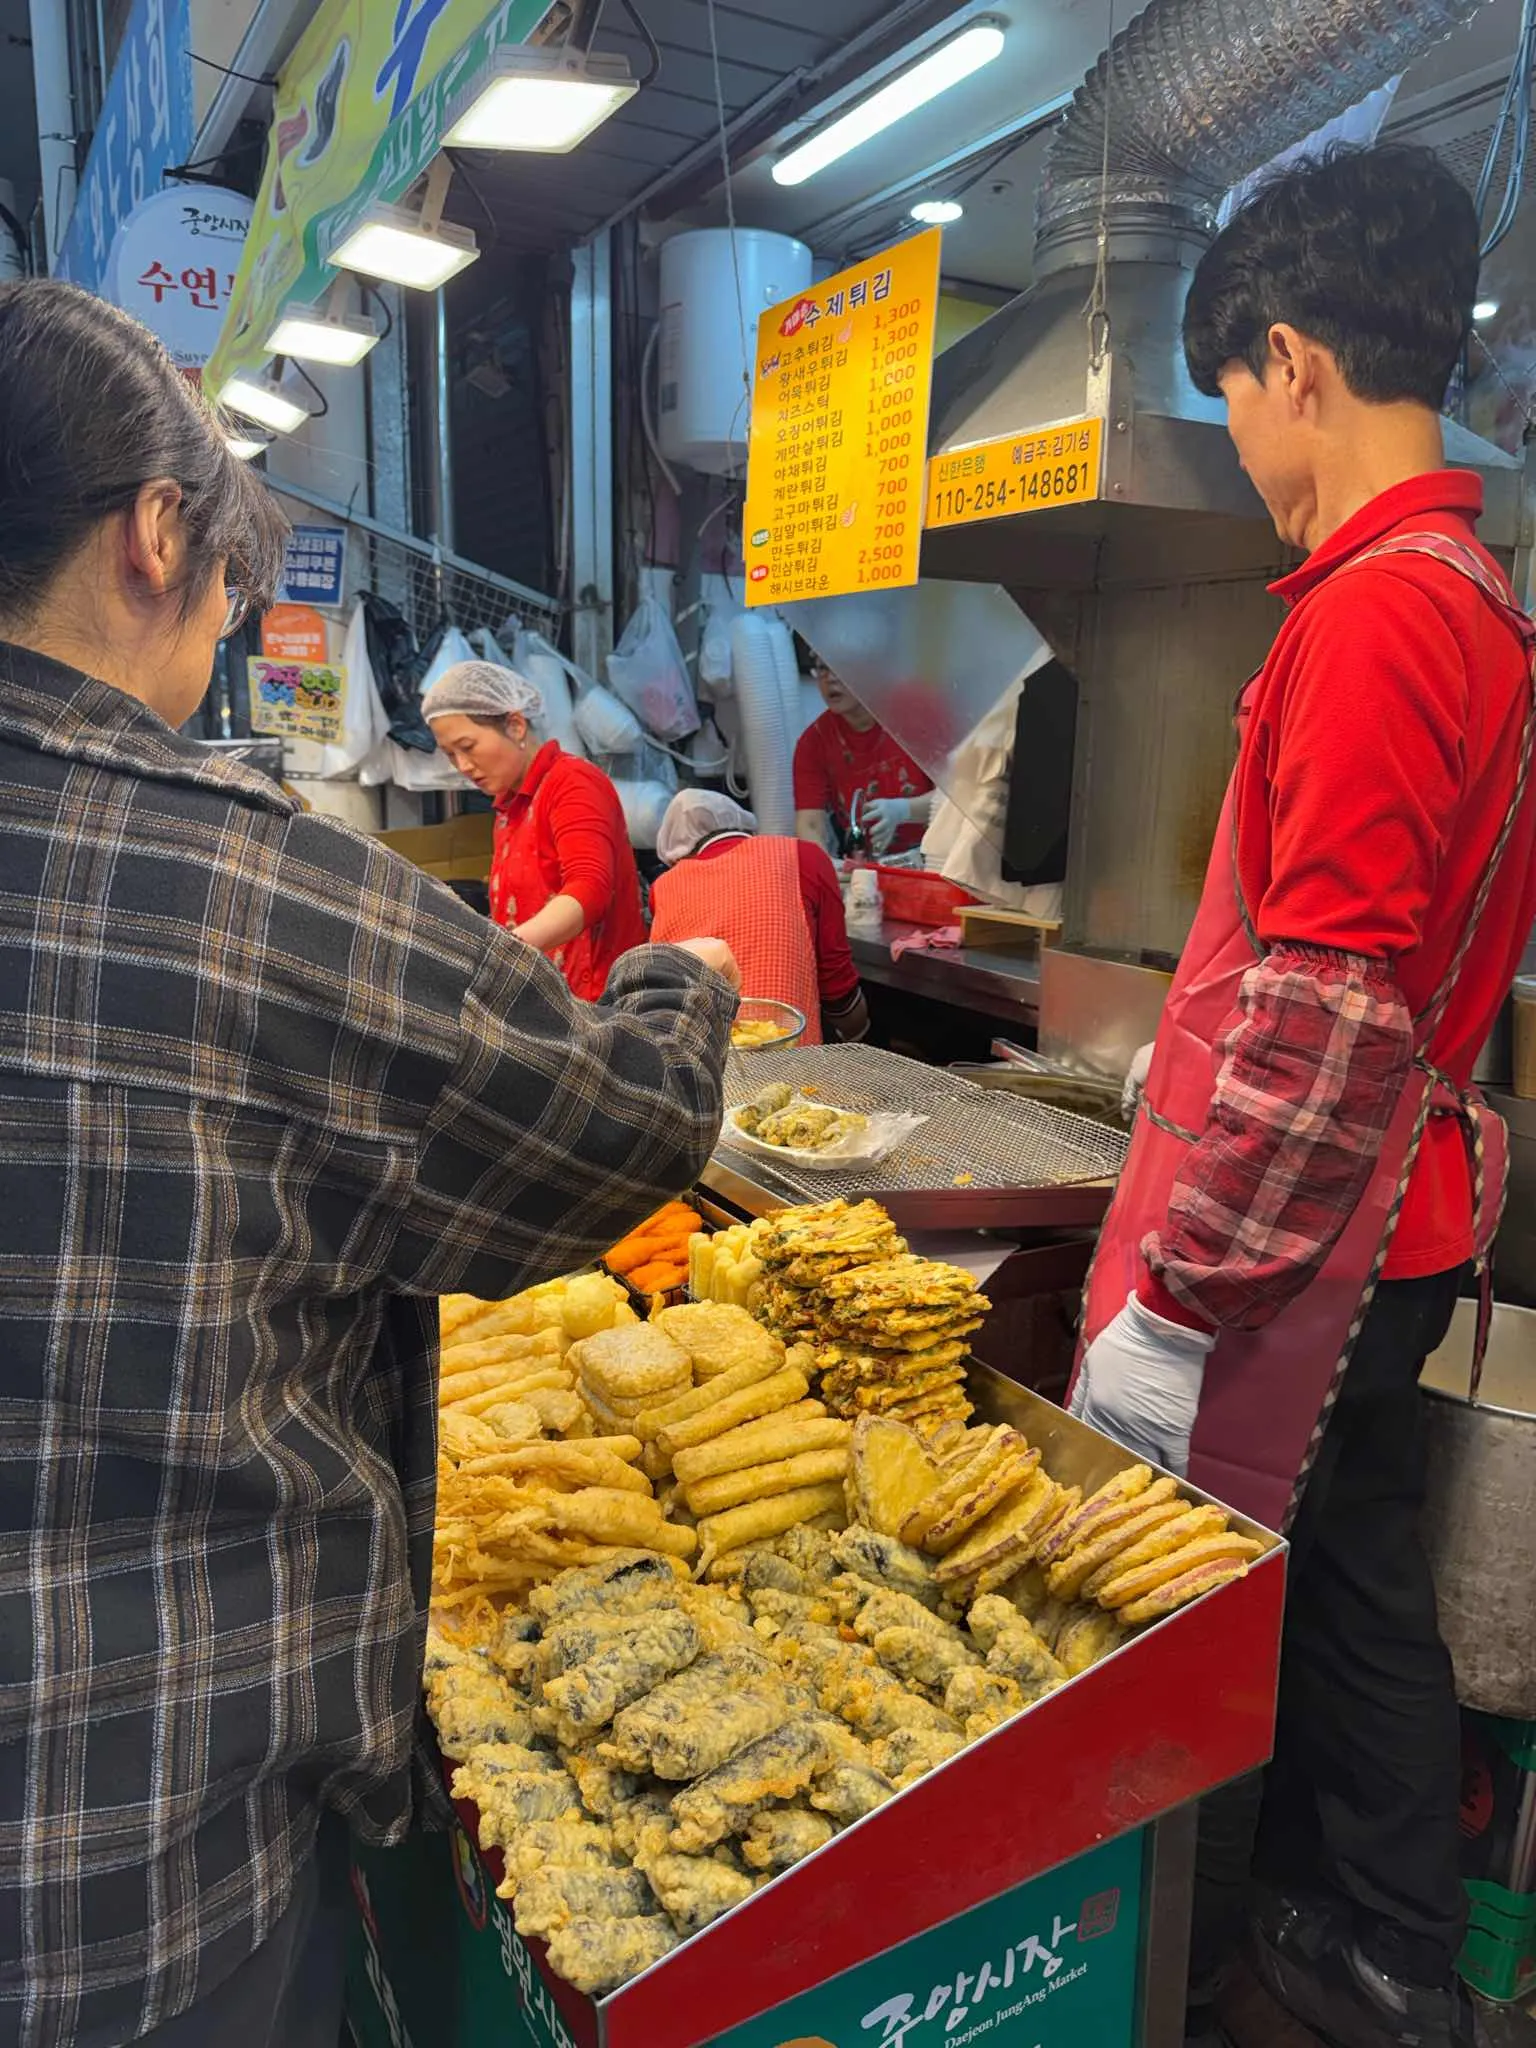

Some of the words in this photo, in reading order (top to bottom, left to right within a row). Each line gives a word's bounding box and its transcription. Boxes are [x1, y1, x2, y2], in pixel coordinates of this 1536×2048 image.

[805, 269, 892, 329] 수제튀김
[779, 349, 848, 387] 왕새우튀김
[872, 321, 919, 351] 1,300
[781, 334, 834, 368] 고추튀김
[874, 299, 921, 330] 1,300
[777, 395, 830, 422] 치즈스틱
[869, 365, 916, 392] 1,000
[778, 374, 831, 403] 어묵튀김
[870, 343, 917, 370] 1,000
[776, 410, 843, 443] 오징어튀김
[867, 387, 914, 414] 1,000
[865, 410, 913, 436] 1,000
[773, 476, 826, 501] 계란튀김
[879, 454, 909, 474] 700
[774, 455, 827, 481] 야채튀김
[864, 432, 911, 458] 1,000
[938, 454, 986, 483] 신한은행
[773, 493, 839, 521] 고구마튀김
[877, 477, 908, 497] 700
[936, 461, 1089, 519] 110-254-148681
[771, 538, 822, 561] 만두튀김
[874, 522, 905, 541] 700
[772, 514, 838, 542] 김말이튀김
[875, 499, 907, 519] 700
[769, 574, 831, 595] 해시브라운
[856, 564, 902, 584] 1,000
[771, 557, 818, 579] 인삼튀김
[858, 544, 904, 564] 2,500
[943, 2009, 994, 2048] Daejeon
[995, 1985, 1047, 2022] JungAng
[1049, 1962, 1089, 1993] Market
